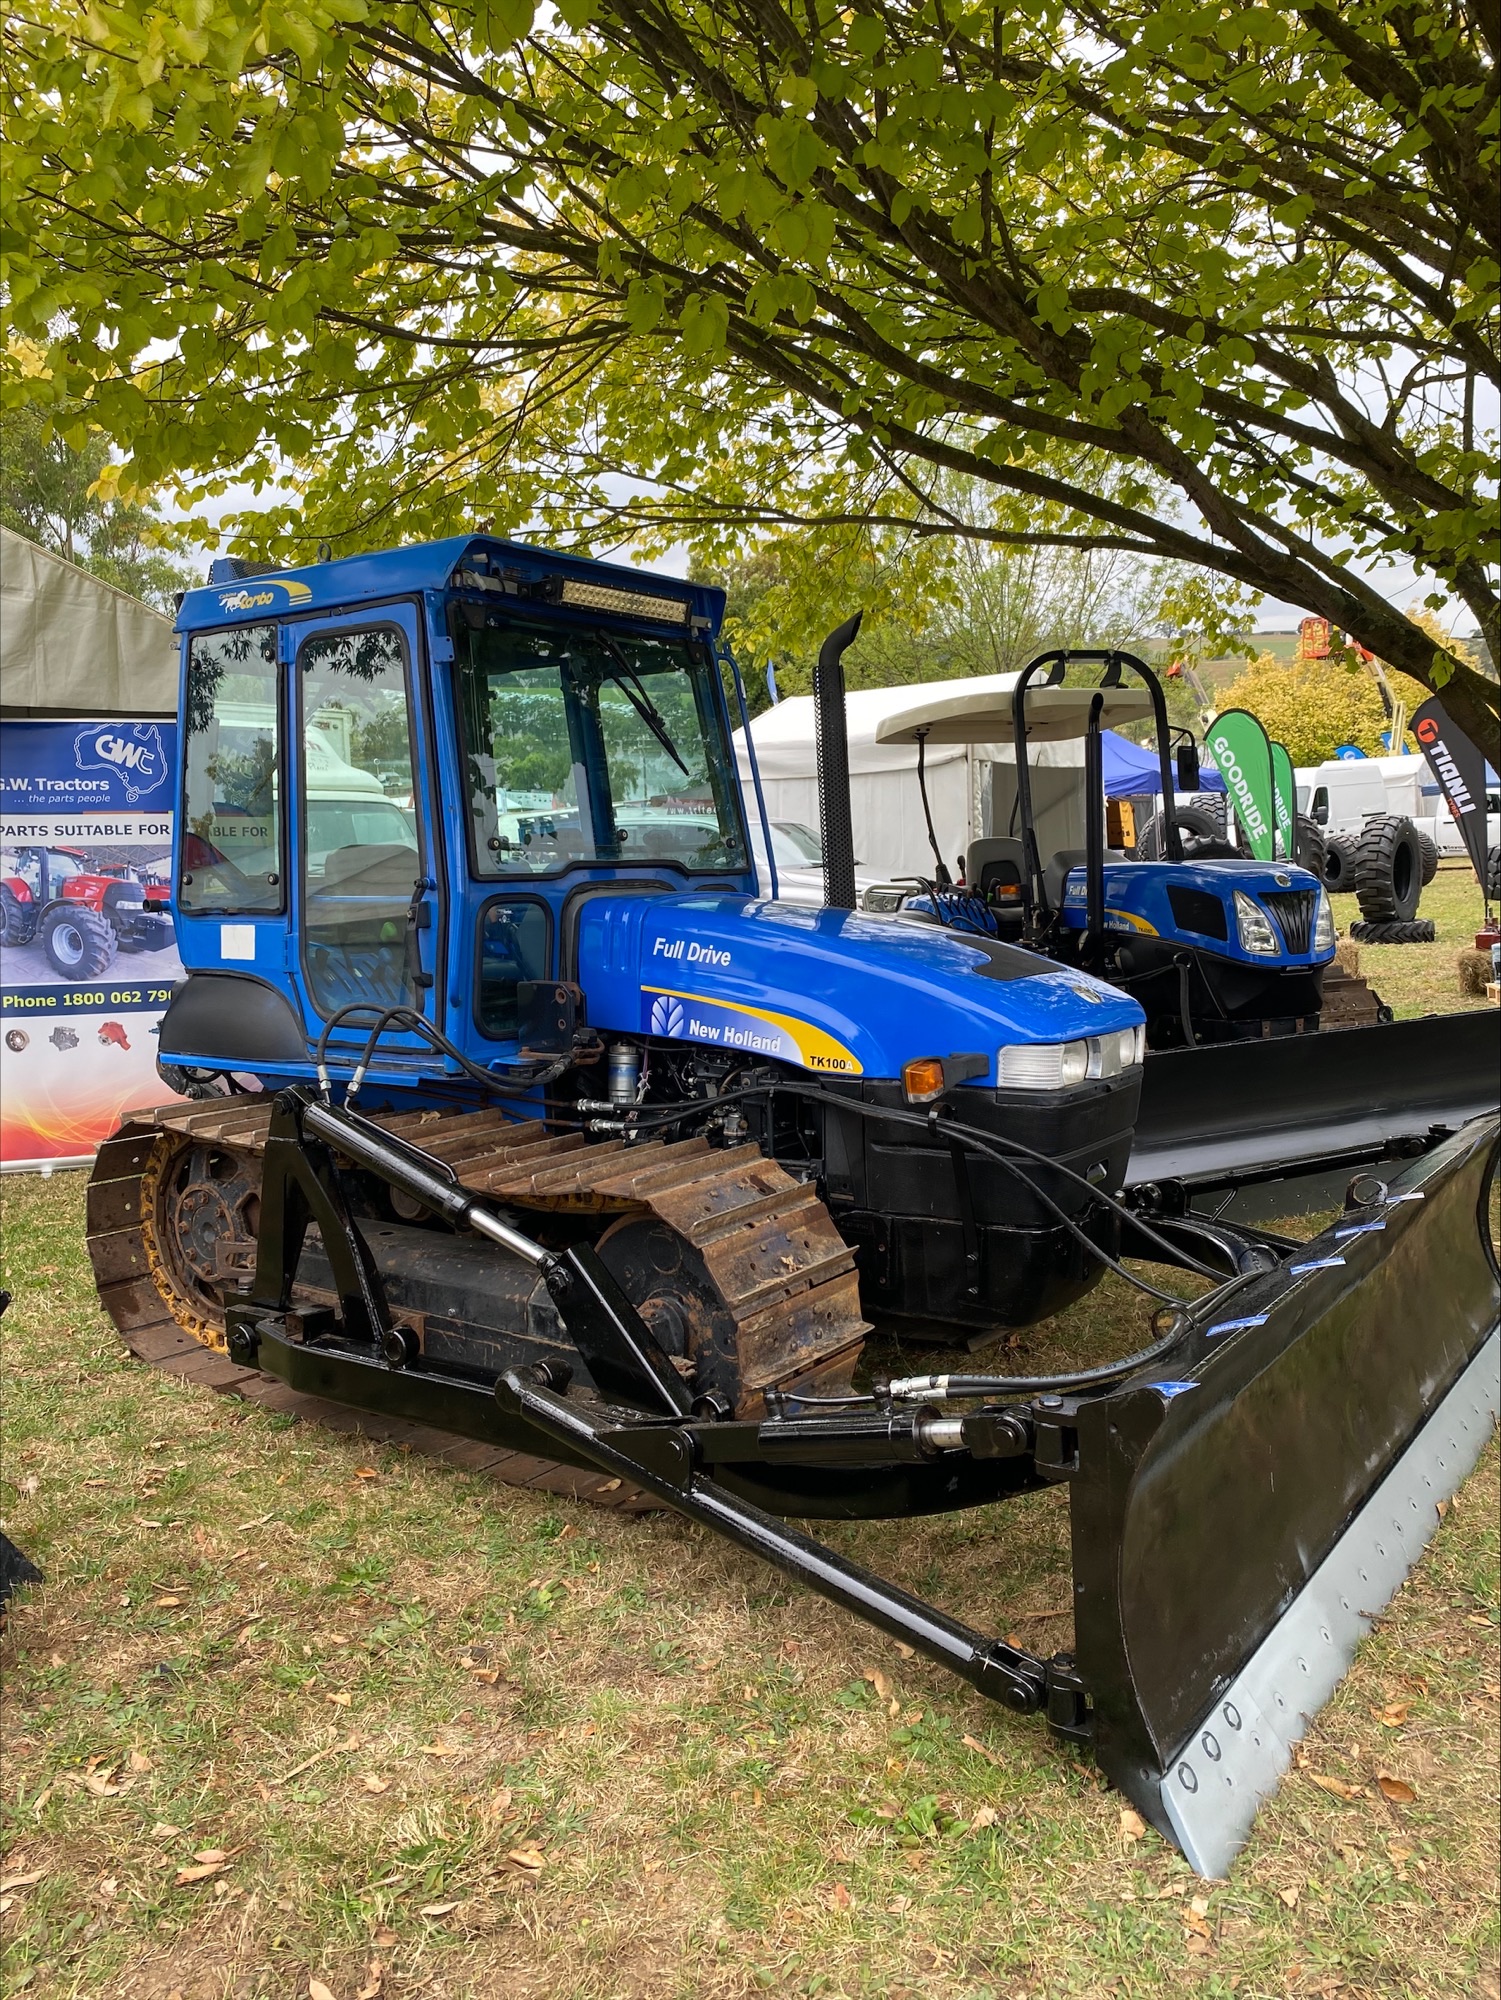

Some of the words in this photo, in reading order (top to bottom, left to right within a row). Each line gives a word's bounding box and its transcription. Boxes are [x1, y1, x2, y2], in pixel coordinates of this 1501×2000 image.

[35, 778, 110, 791] Tractors
[1429, 740, 1477, 814] TIANLI
[1214, 736, 1268, 840] GOODRIDE
[28, 795, 45, 803] the
[48, 795, 74, 804] parts
[77, 794, 111, 804] people
[1274, 780, 1292, 830] DRIDE
[54, 824, 133, 836] SUITABLE
[138, 824, 171, 836] FOR
[242, 826, 268, 837] FOR
[653, 937, 685, 959] Full
[686, 942, 732, 967] Drive
[2, 995, 57, 1008] Phone
[63, 993, 105, 1006] 1800
[111, 991, 142, 1004] 062
[689, 1019, 720, 1040] New
[723, 1026, 781, 1052] Holland
[810, 1055, 853, 1070] TK100A
